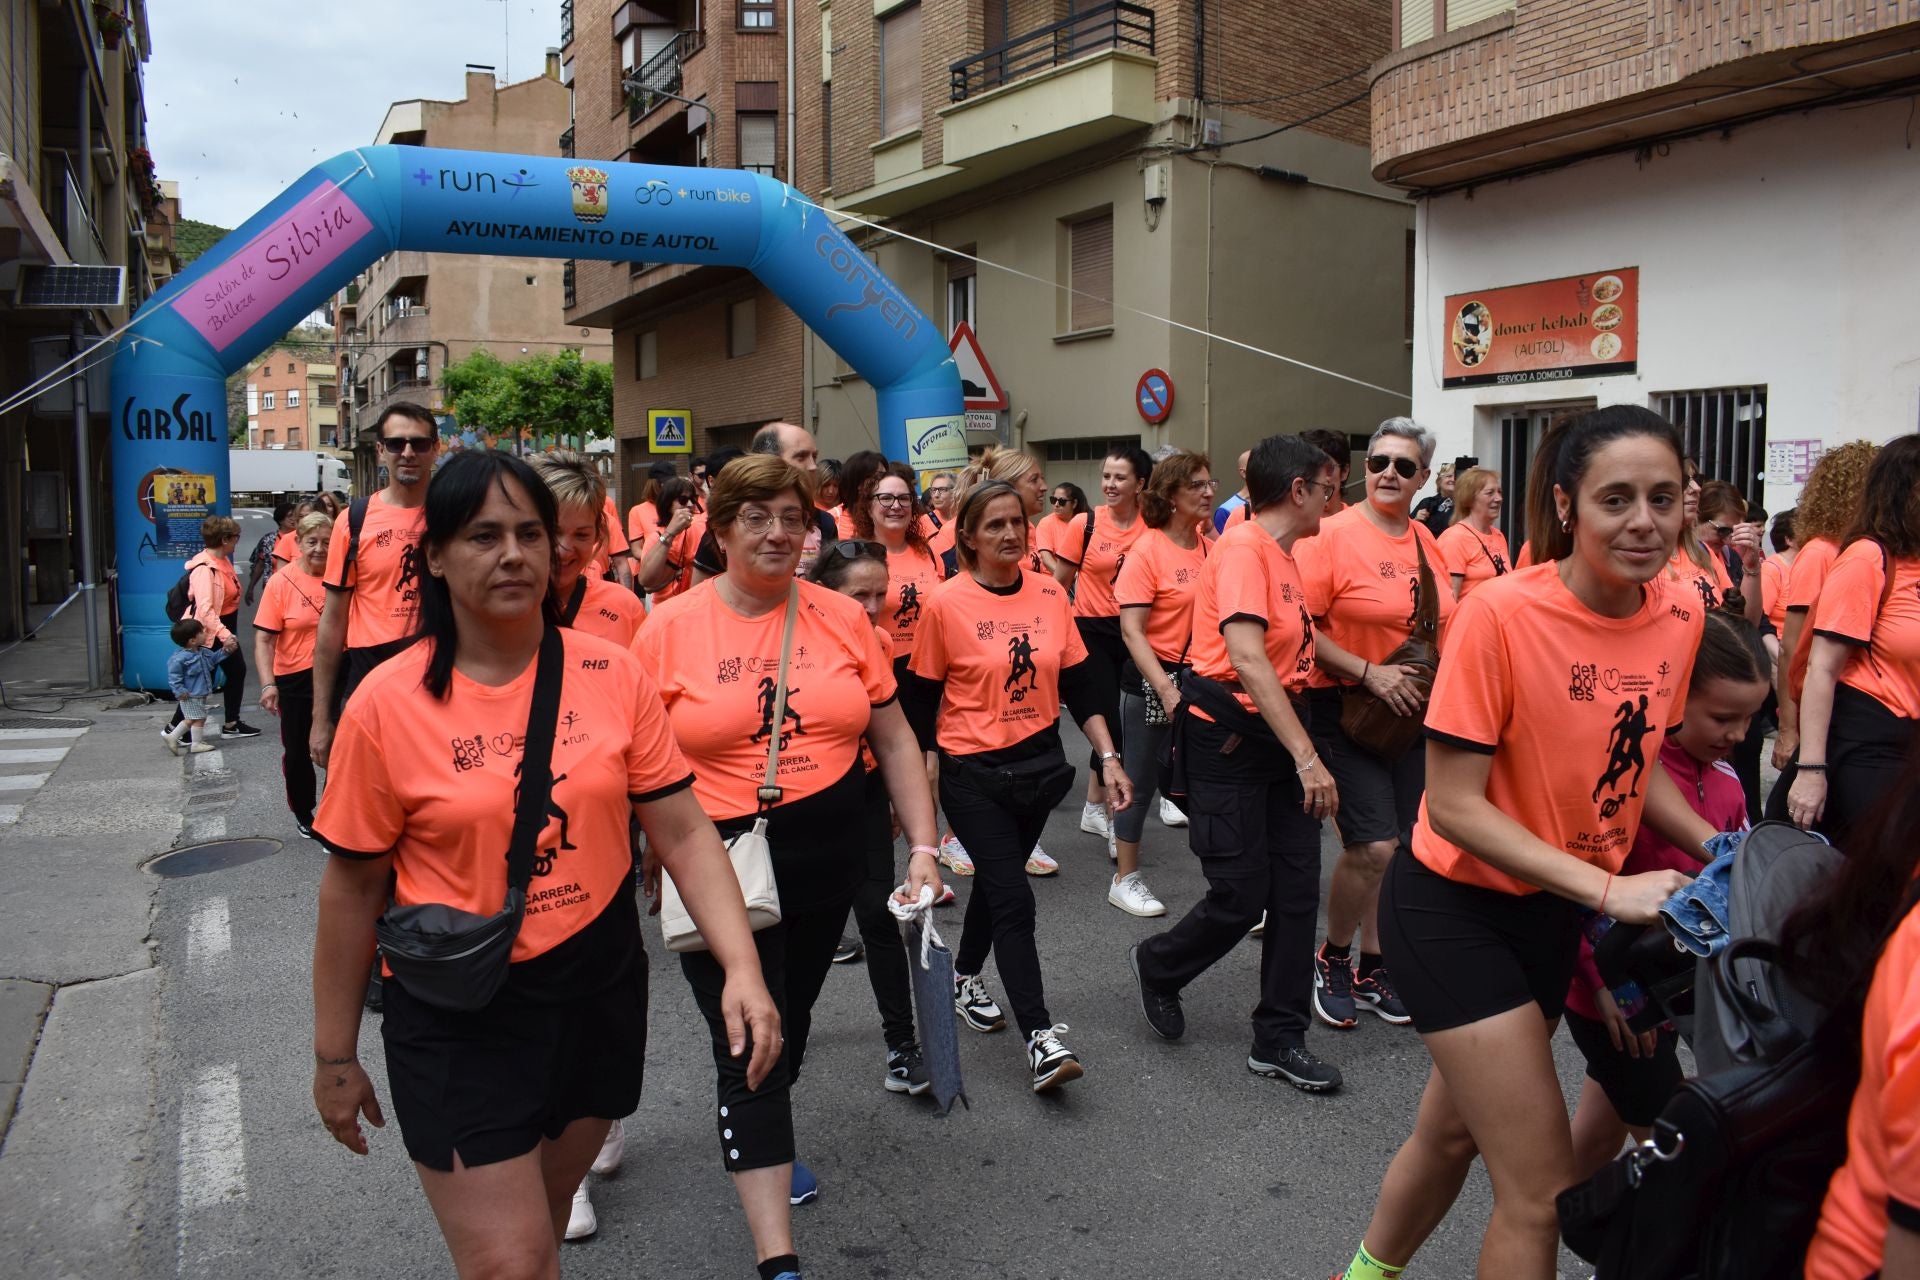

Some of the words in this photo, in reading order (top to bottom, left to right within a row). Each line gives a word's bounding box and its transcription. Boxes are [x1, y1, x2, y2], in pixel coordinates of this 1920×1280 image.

[265, 205, 353, 281] Silvia
[446, 220, 614, 246] AYUNTAMIENTO
[619, 231, 648, 247] DE
[652, 233, 720, 251] AUTOL
[204, 278, 241, 309] Salón
[242, 263, 256, 280] de
[207, 290, 256, 331] Belleza
[1494, 322, 1536, 337] doner
[1540, 312, 1588, 331] kebab
[1514, 340, 1565, 359] (AUTOL)
[1497, 373, 1528, 384] SERVICIO
[1529, 372, 1535, 381] A
[1536, 369, 1573, 380] DOMICILIO
[755, 762, 765, 770] IX
[776, 756, 811, 767] ARRERA
[1577, 832, 1590, 842] IX
[1592, 827, 1626, 844] CARRERA
[1566, 841, 1602, 853] CONTRA
[541, 903, 553, 912] EL
